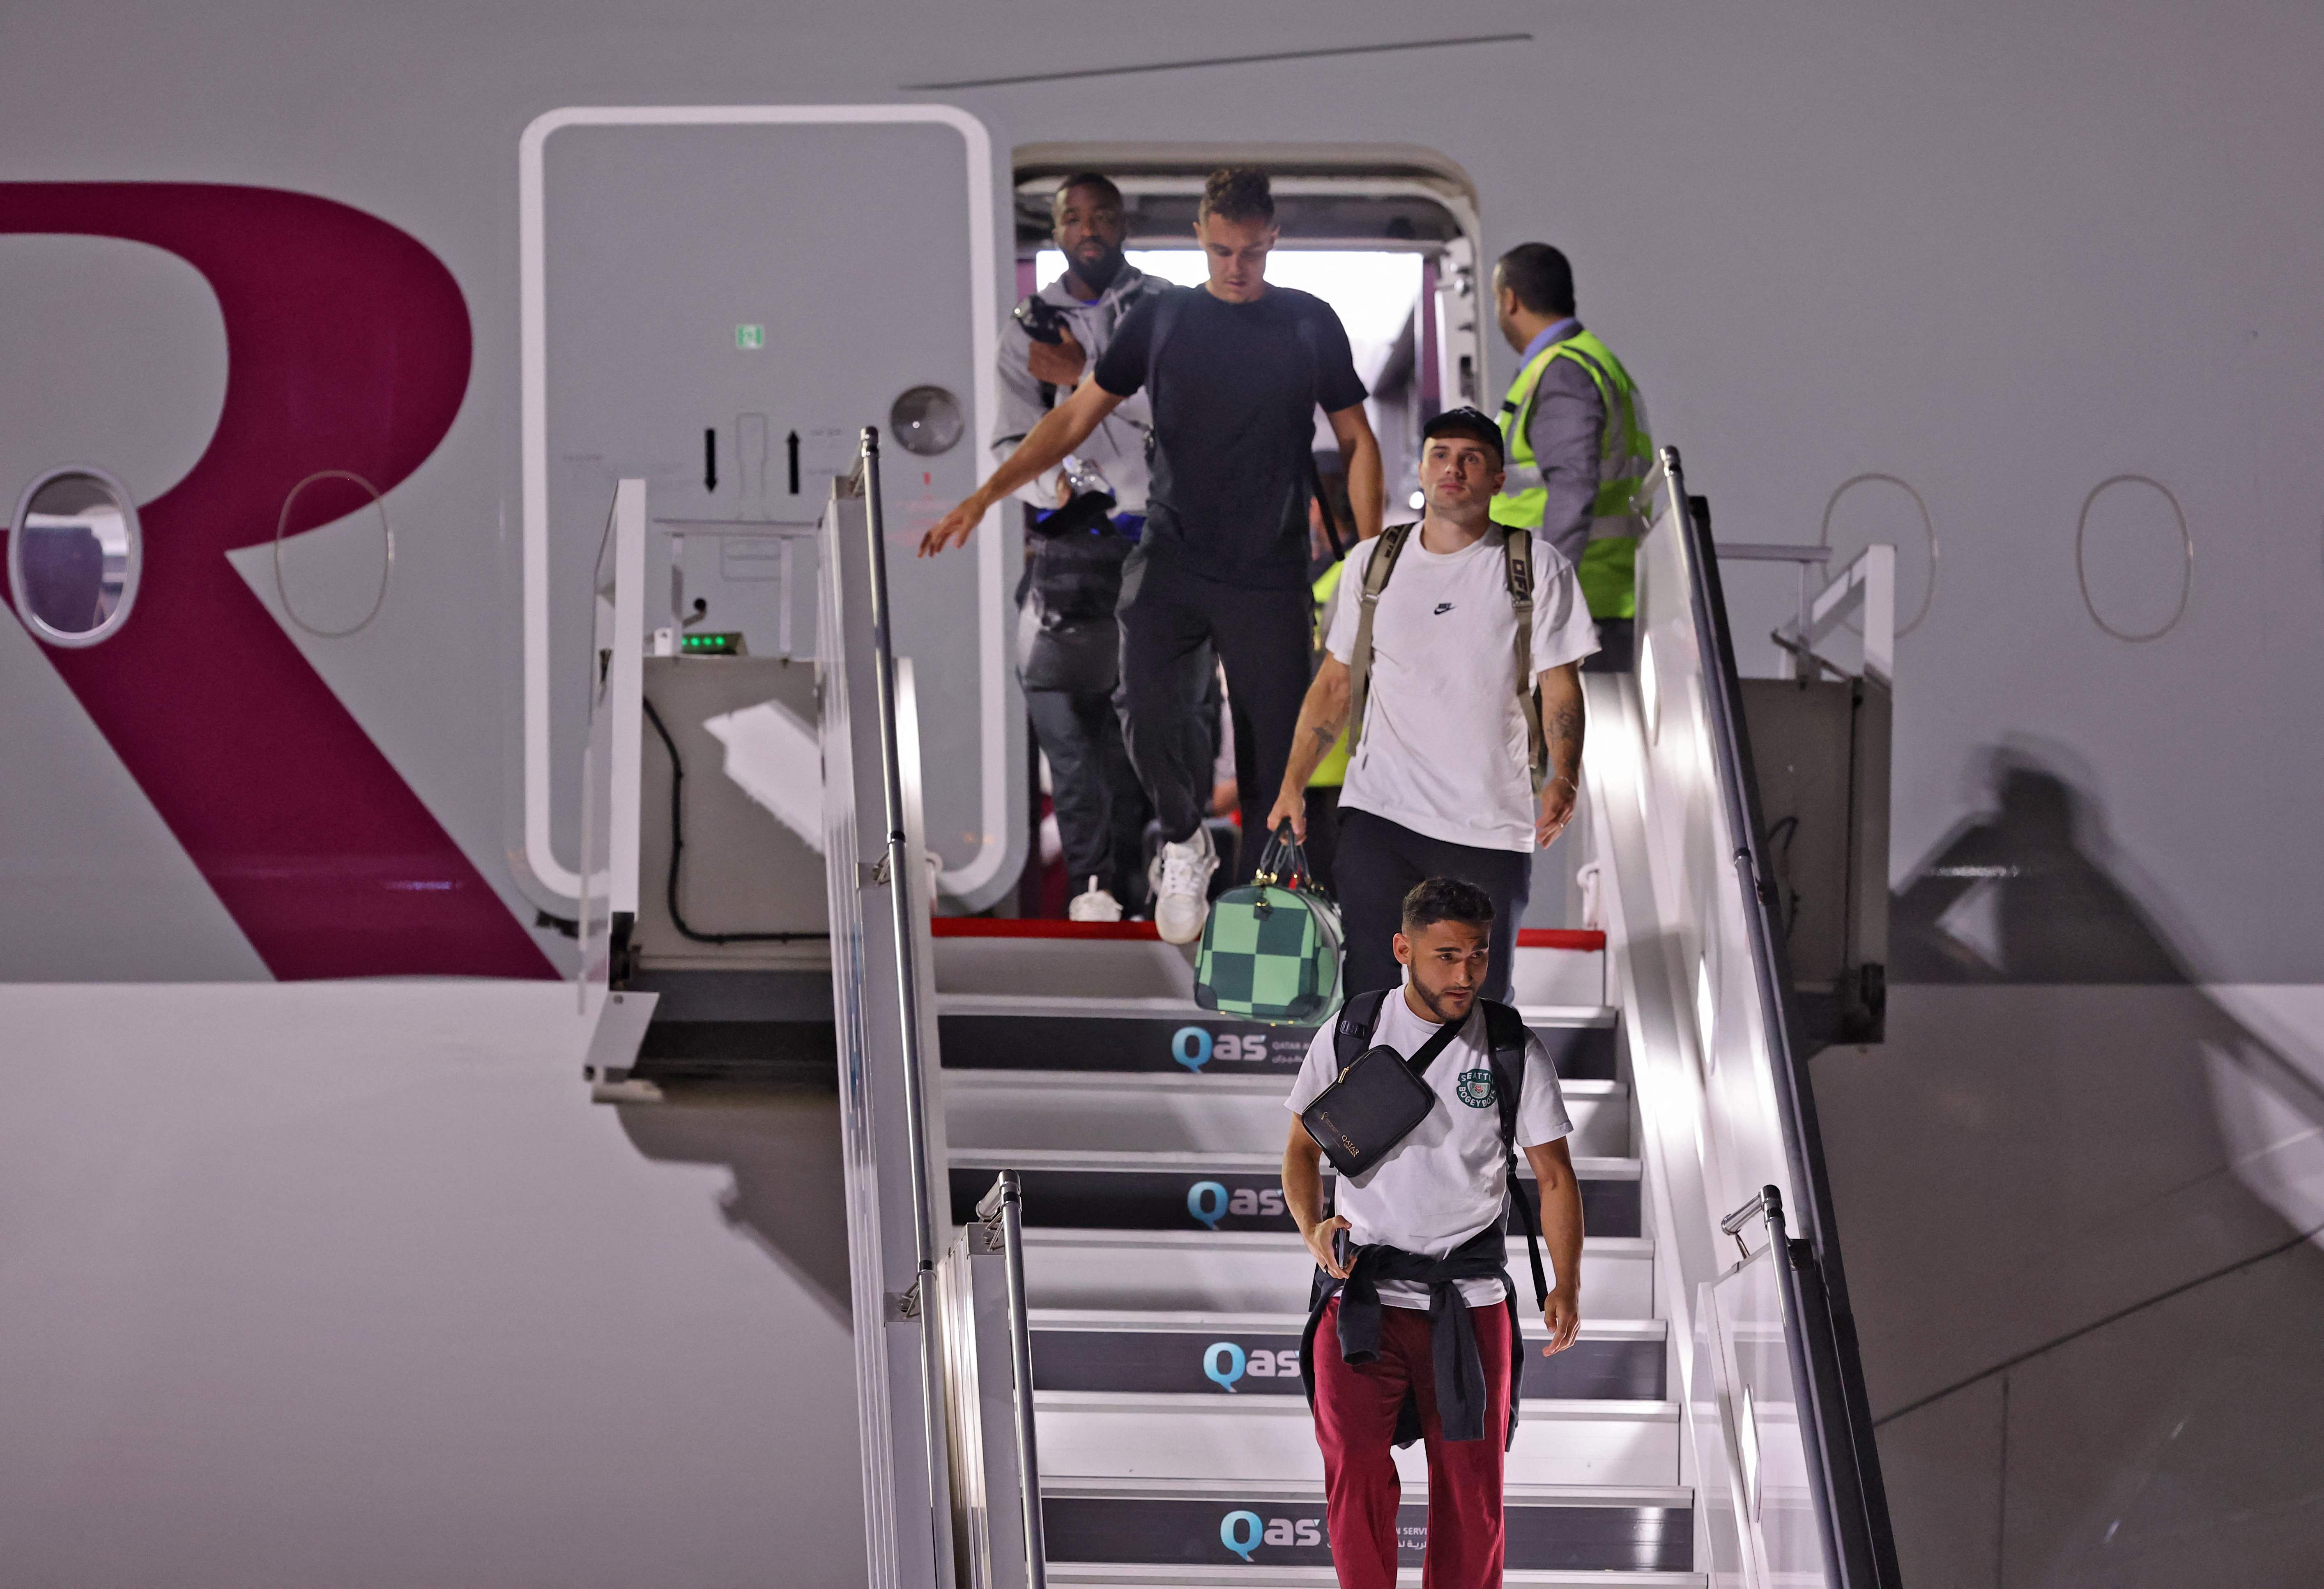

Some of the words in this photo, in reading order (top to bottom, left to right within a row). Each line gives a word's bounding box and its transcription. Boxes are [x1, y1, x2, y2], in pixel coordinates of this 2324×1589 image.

[1171, 1026, 1268, 1074] Qas
[1341, 1135, 1360, 1155] QATAR
[1187, 1181, 1285, 1231] Qas
[1203, 1341, 1301, 1393] Qas
[1220, 1510, 1321, 1562] Qas
[1403, 1527, 1427, 1535] SERVI
